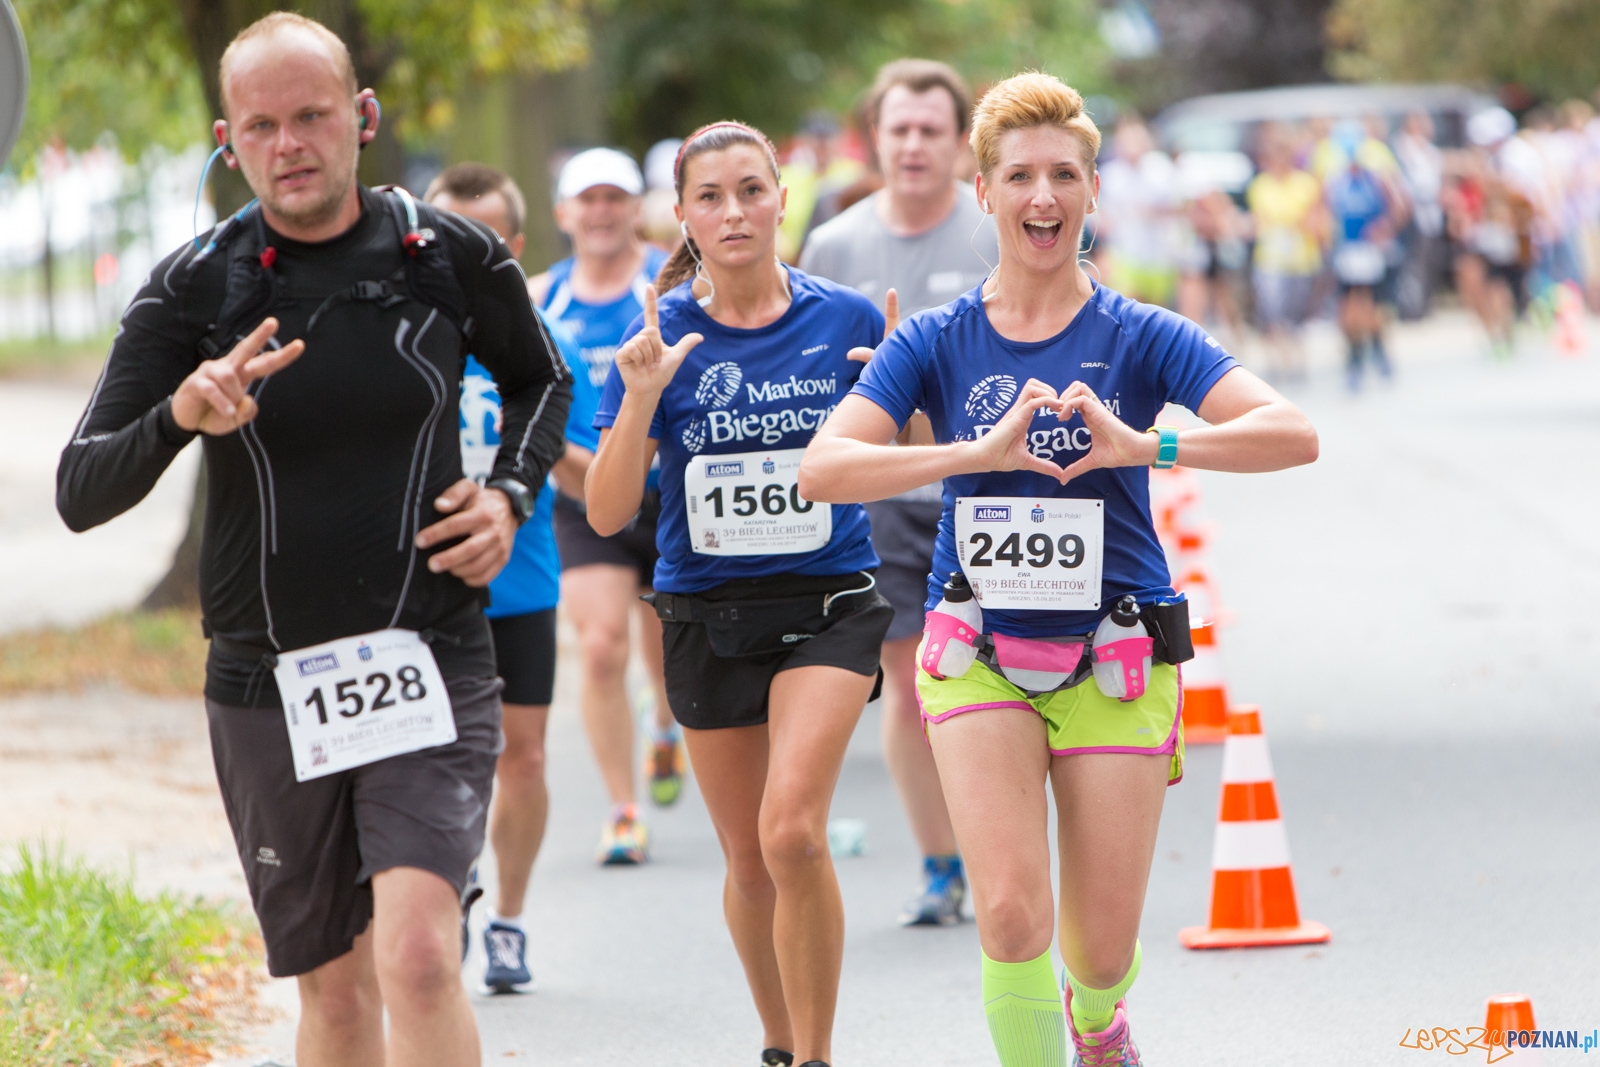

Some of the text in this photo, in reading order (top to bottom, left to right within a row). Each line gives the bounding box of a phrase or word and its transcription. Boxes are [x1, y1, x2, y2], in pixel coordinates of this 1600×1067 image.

[801, 344, 824, 356] CRAFT
[745, 372, 836, 404] Markowi
[704, 483, 814, 518] 1560
[722, 522, 818, 537] 39 BIEG LECHITÓW
[969, 532, 1085, 569] 2499
[984, 579, 1087, 590] 39 BIEG LECHITÓW
[305, 665, 427, 724] 1528
